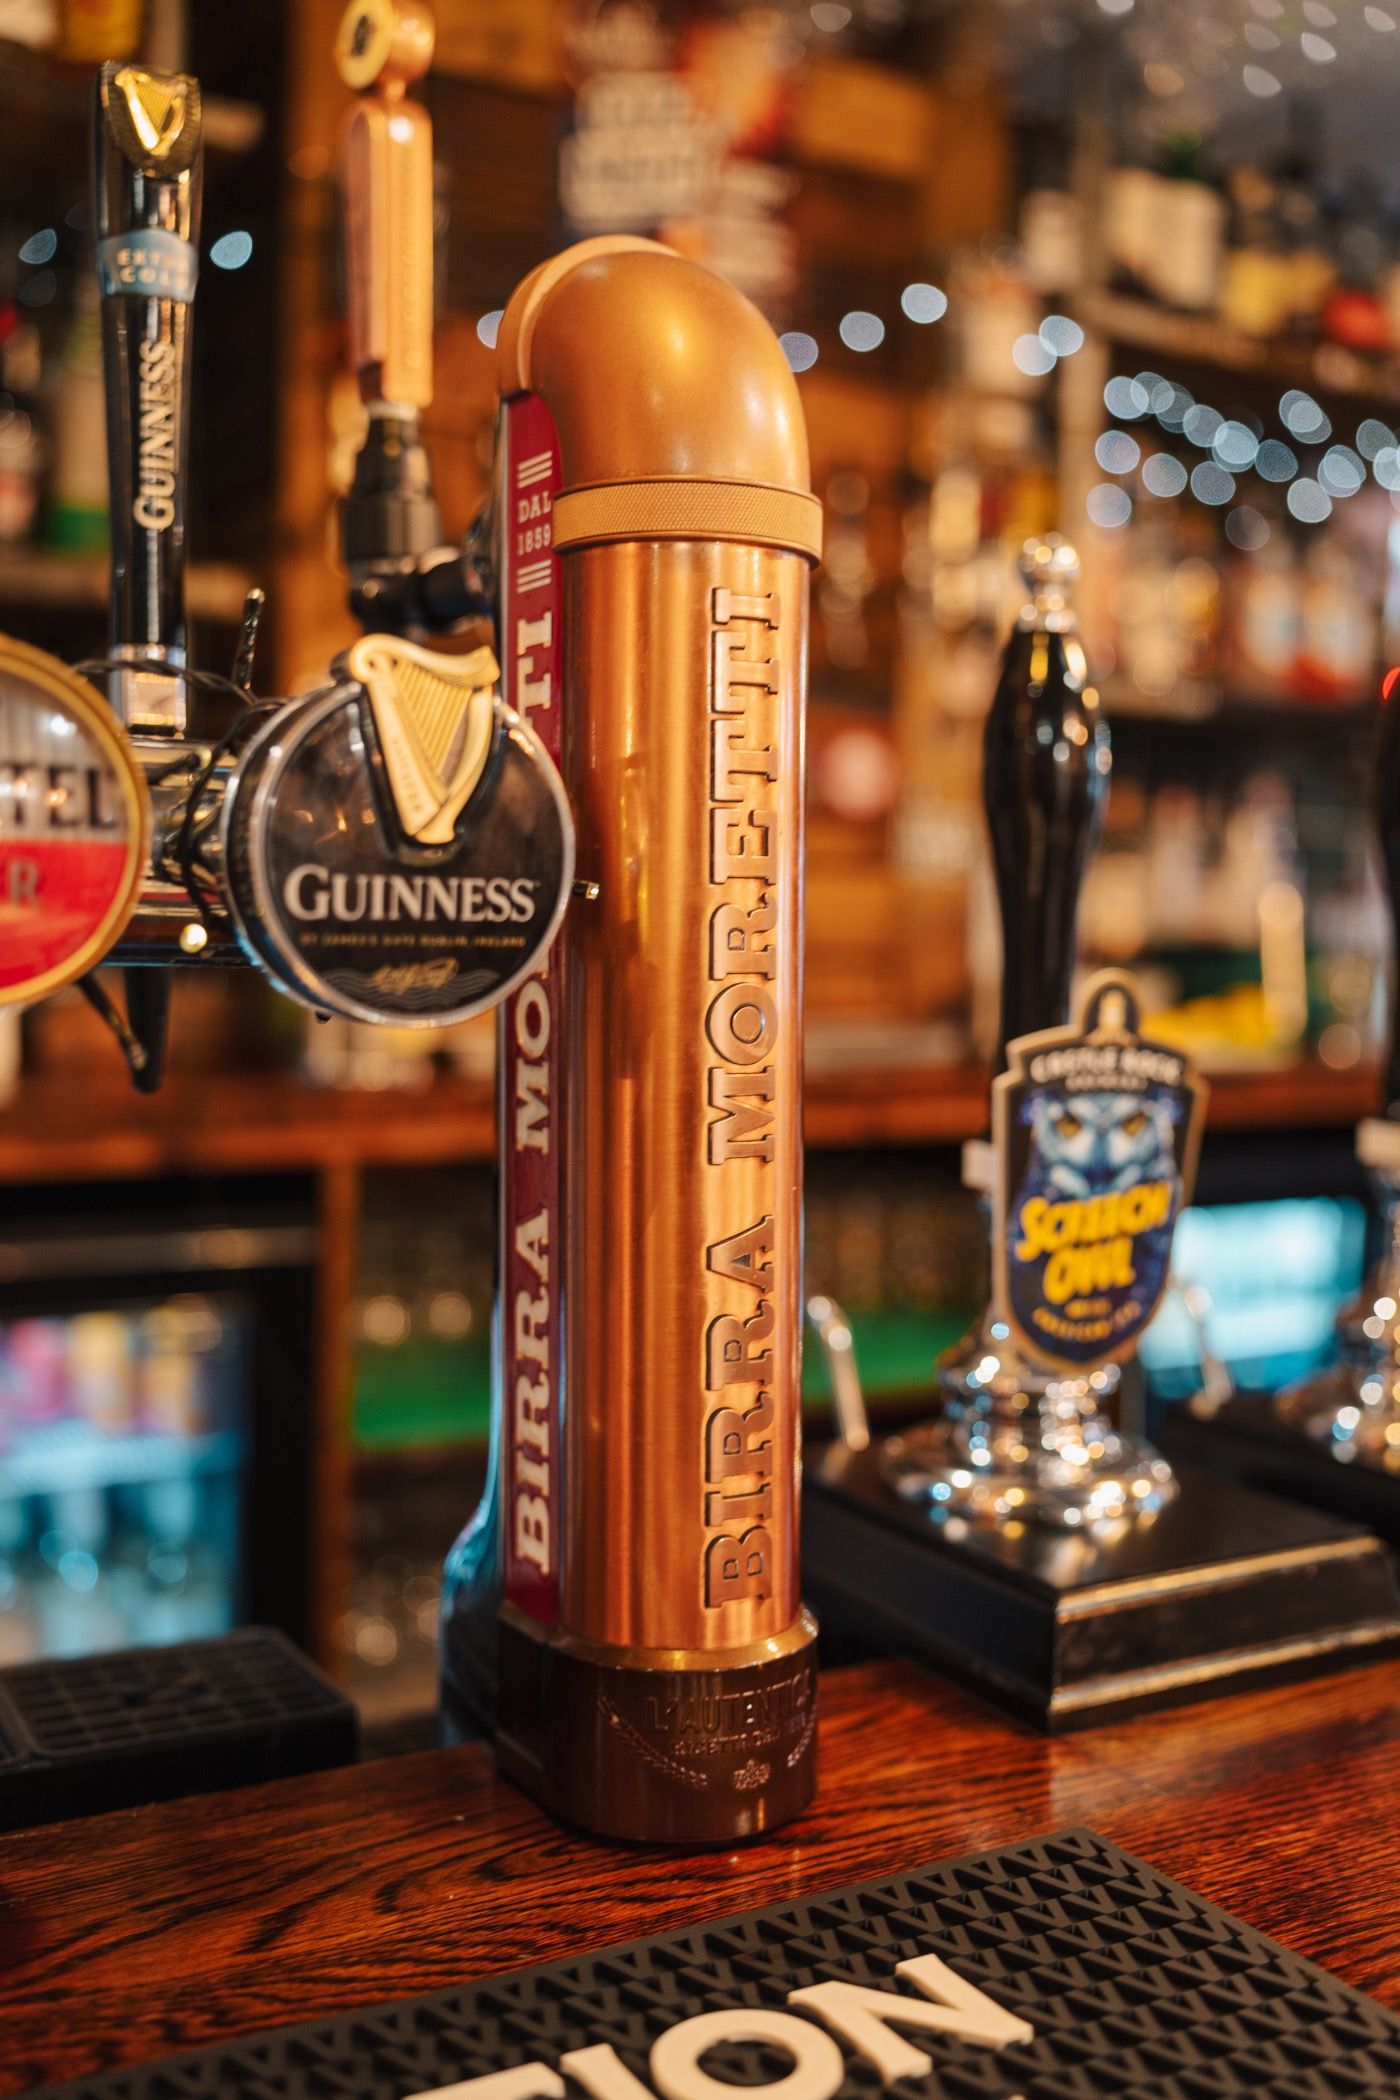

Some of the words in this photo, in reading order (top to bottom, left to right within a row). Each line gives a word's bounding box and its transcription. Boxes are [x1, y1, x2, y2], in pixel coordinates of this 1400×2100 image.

[116, 248, 190, 271] EXT
[133, 340, 176, 532] GUINNESS
[518, 491, 551, 524] DAL
[518, 523, 551, 556] 1859
[284, 862, 536, 923] GUINNESS
[515, 611, 552, 1155] MOTI
[705, 586, 779, 1166] MORETTI
[516, 1209, 550, 1575] BIRRA
[705, 1214, 776, 1609] BIRRA
[402, 1953, 1034, 2100] ION
